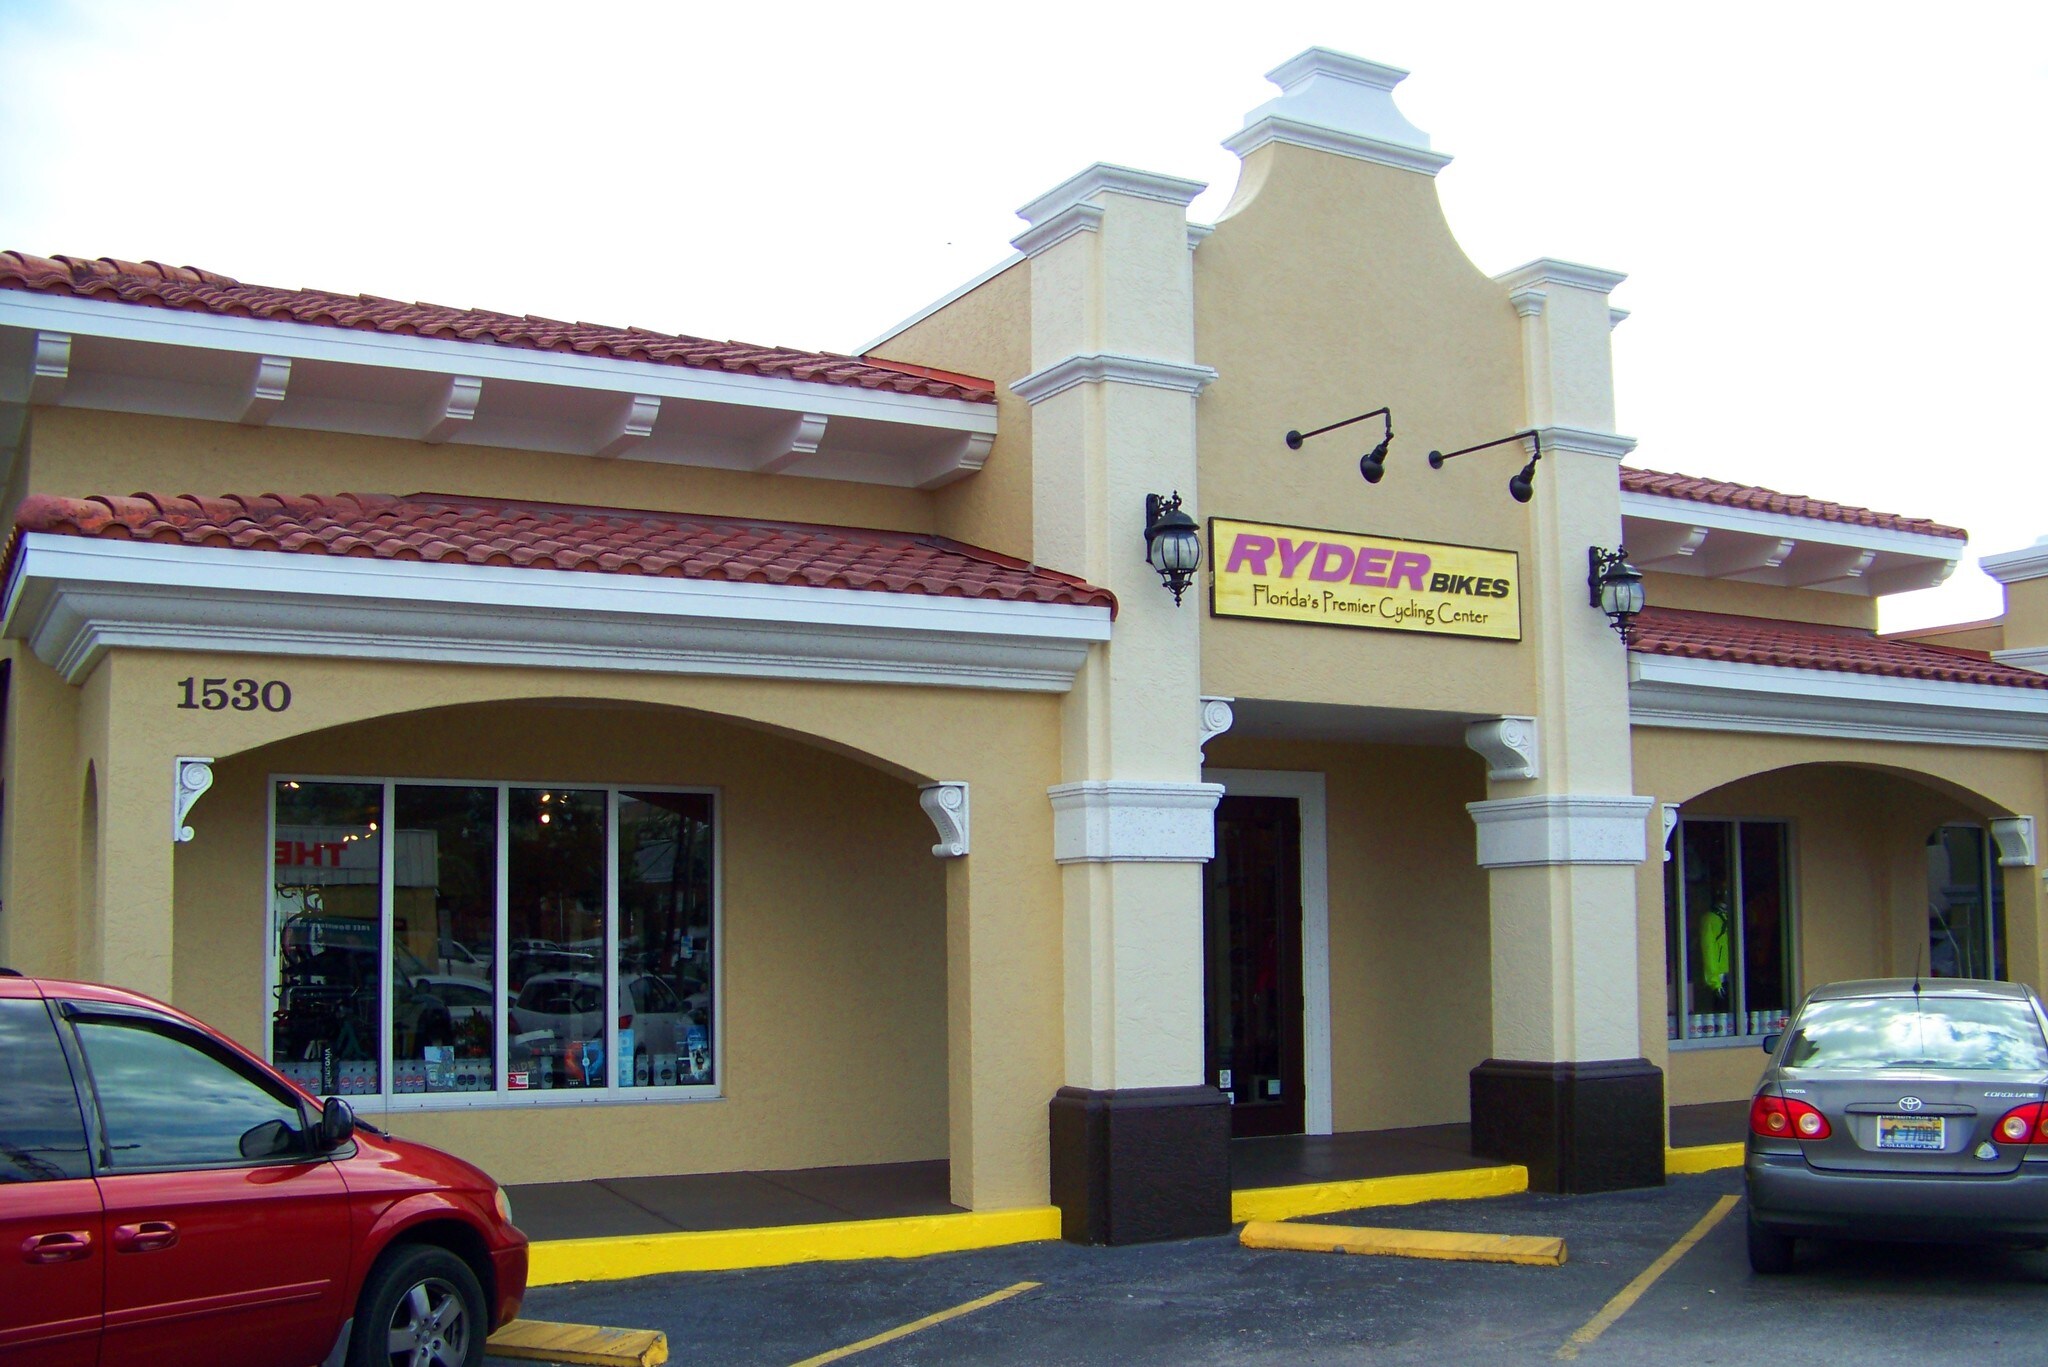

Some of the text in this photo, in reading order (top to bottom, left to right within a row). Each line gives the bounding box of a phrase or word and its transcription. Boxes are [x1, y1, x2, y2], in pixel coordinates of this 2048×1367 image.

[1225, 533, 1510, 598] RYDER BIKES
[1253, 584, 1489, 625] Florida's Premier Cycling Center
[177, 677, 292, 712] 1530
